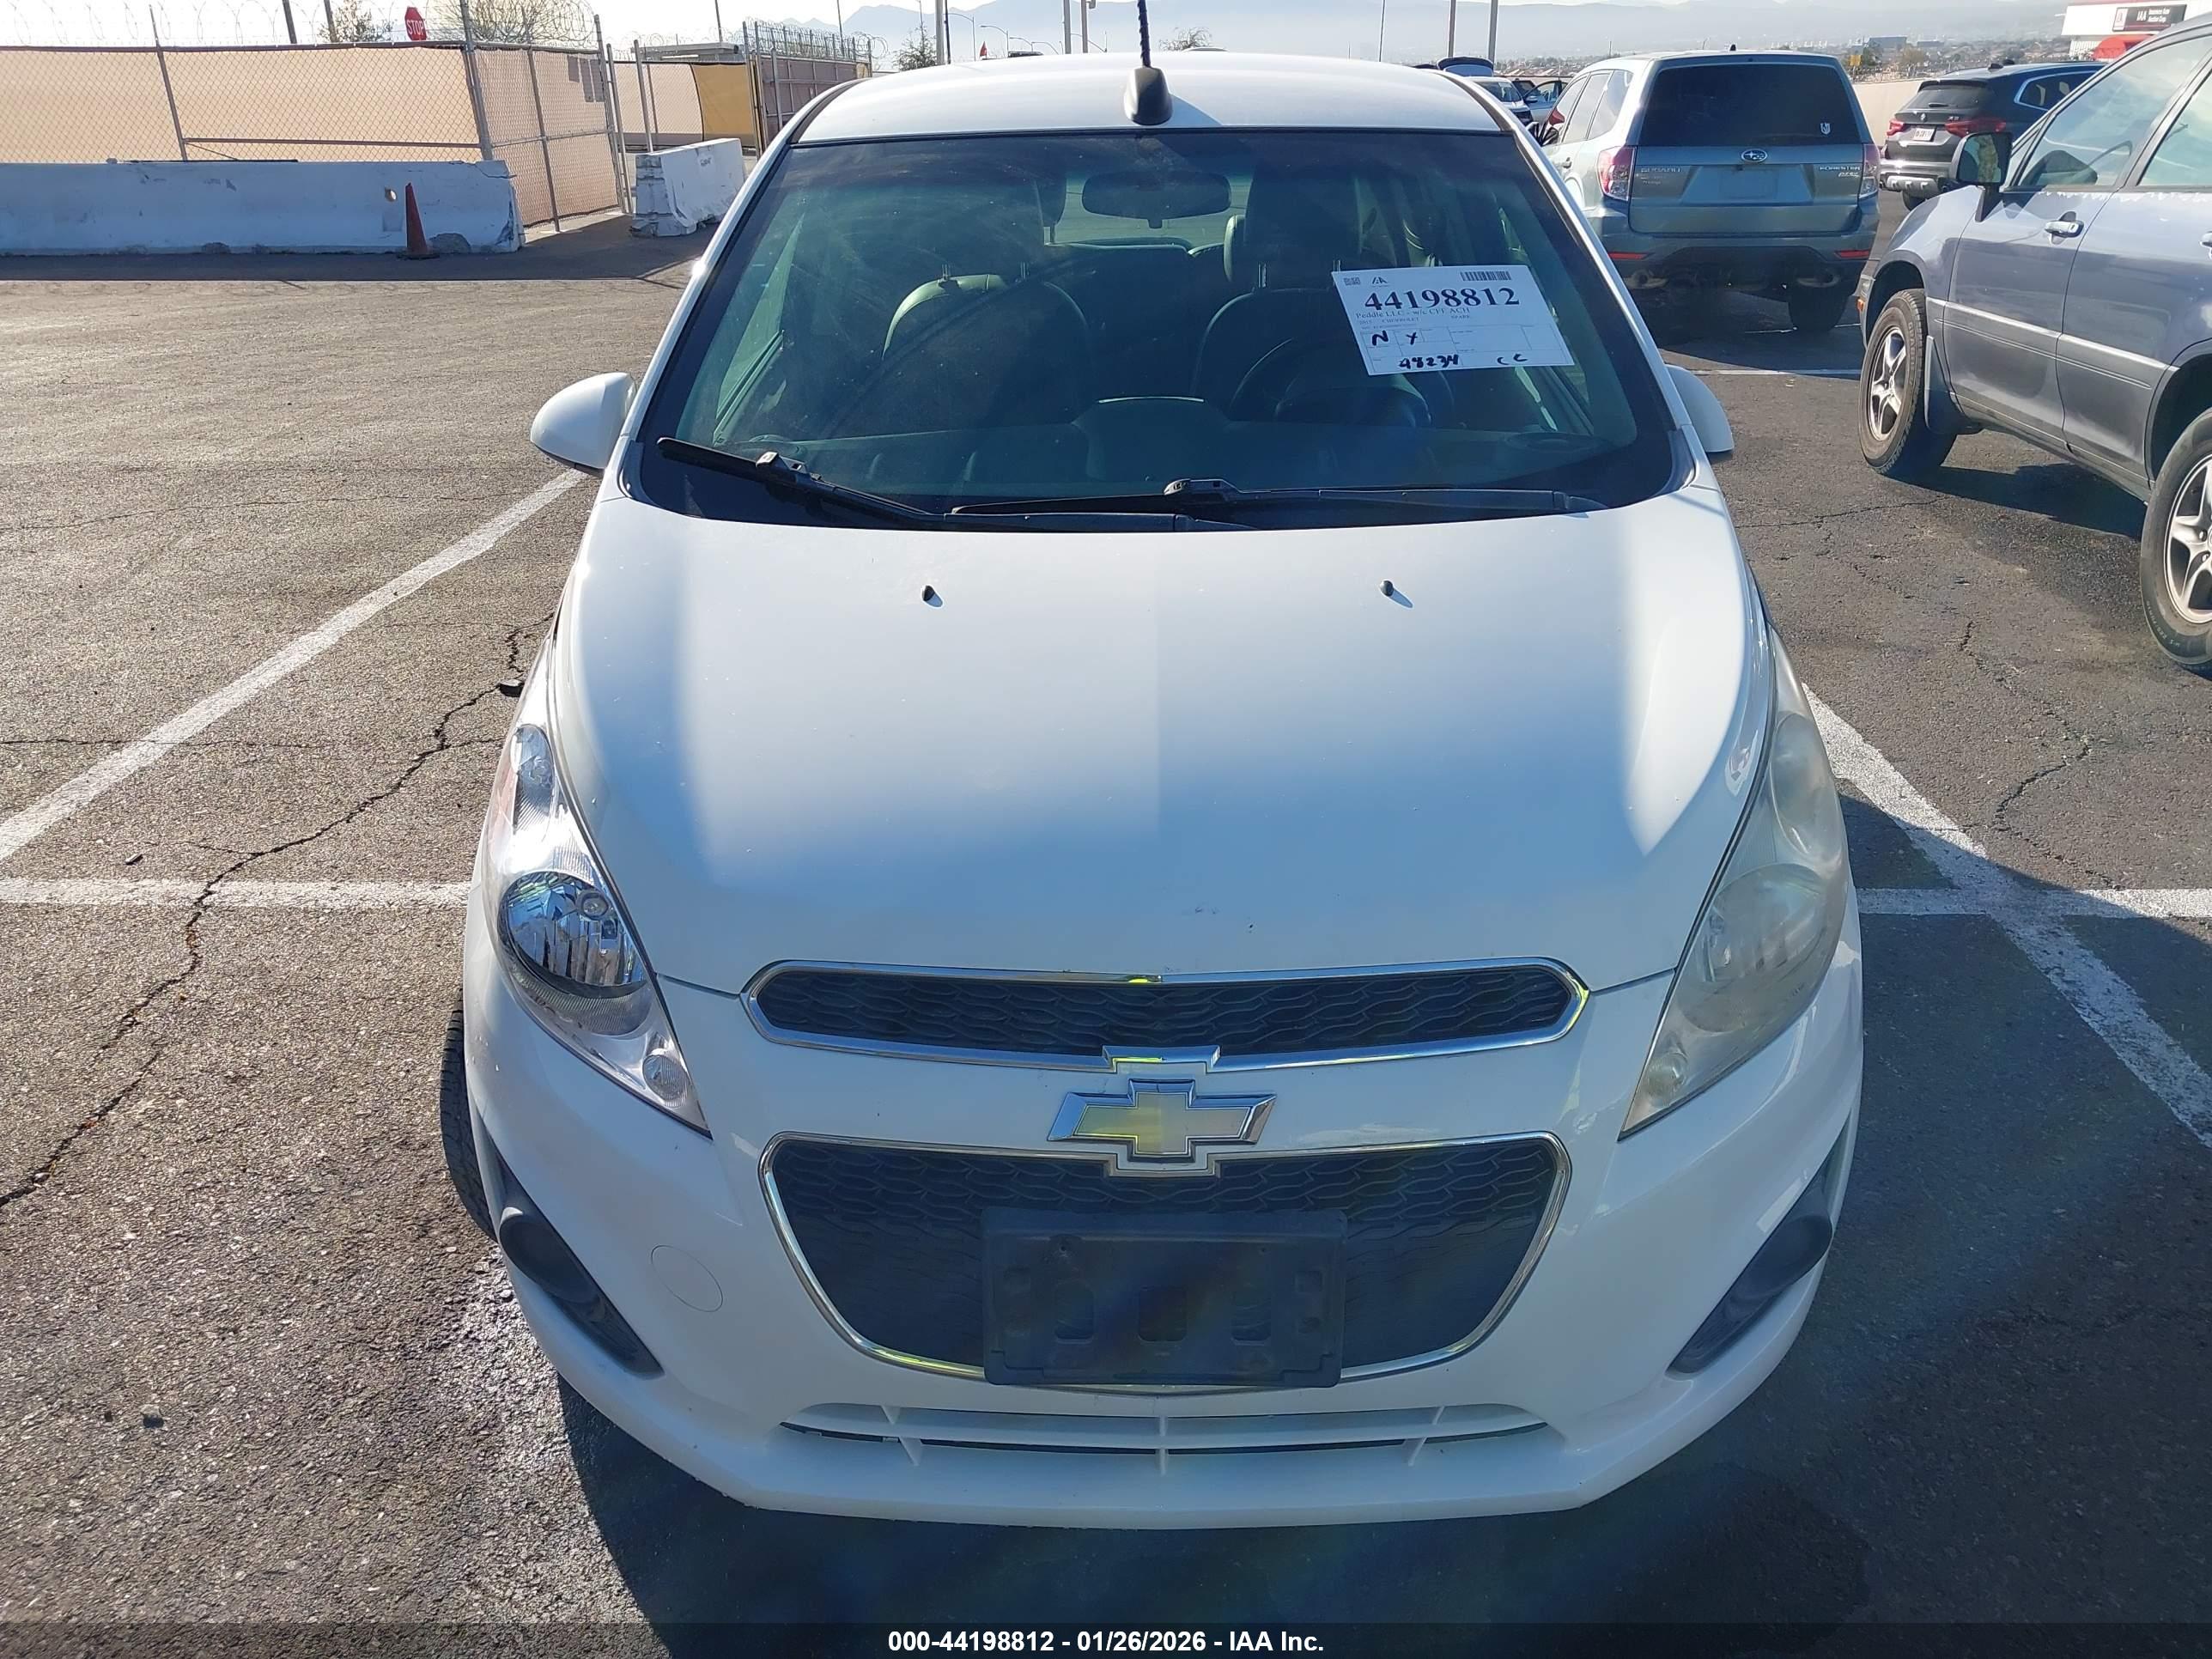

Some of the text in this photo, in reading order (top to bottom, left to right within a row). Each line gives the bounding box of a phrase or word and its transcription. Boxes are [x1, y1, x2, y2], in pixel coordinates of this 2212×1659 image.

[406, 19, 424, 35] STOP
[1364, 288, 1519, 311] 44198812
[1372, 330, 1389, 346] N
